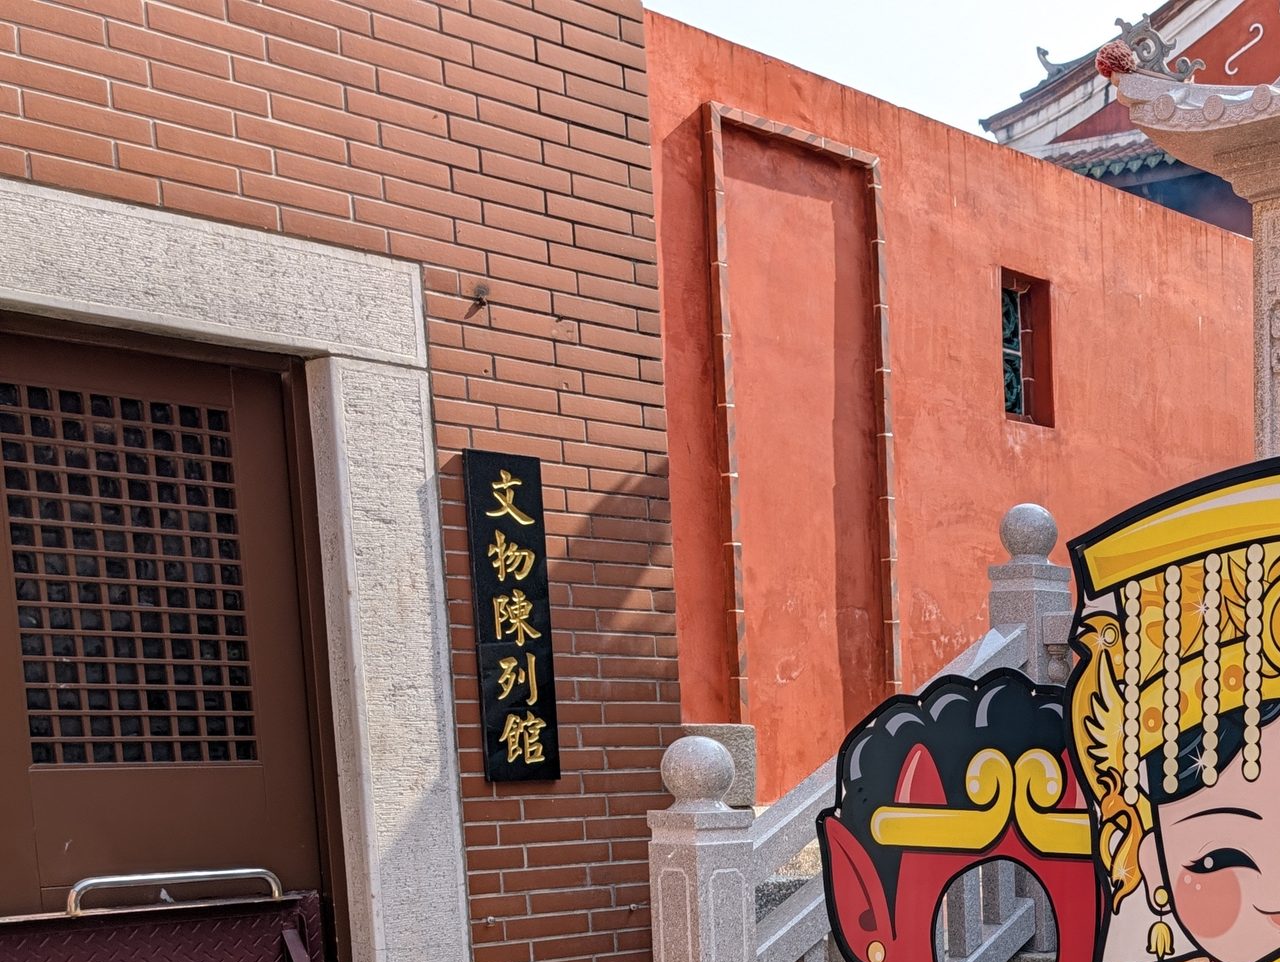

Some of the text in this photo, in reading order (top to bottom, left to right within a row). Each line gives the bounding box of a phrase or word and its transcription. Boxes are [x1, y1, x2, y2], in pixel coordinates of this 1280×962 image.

[485, 468, 546, 764] 文物陳列館
